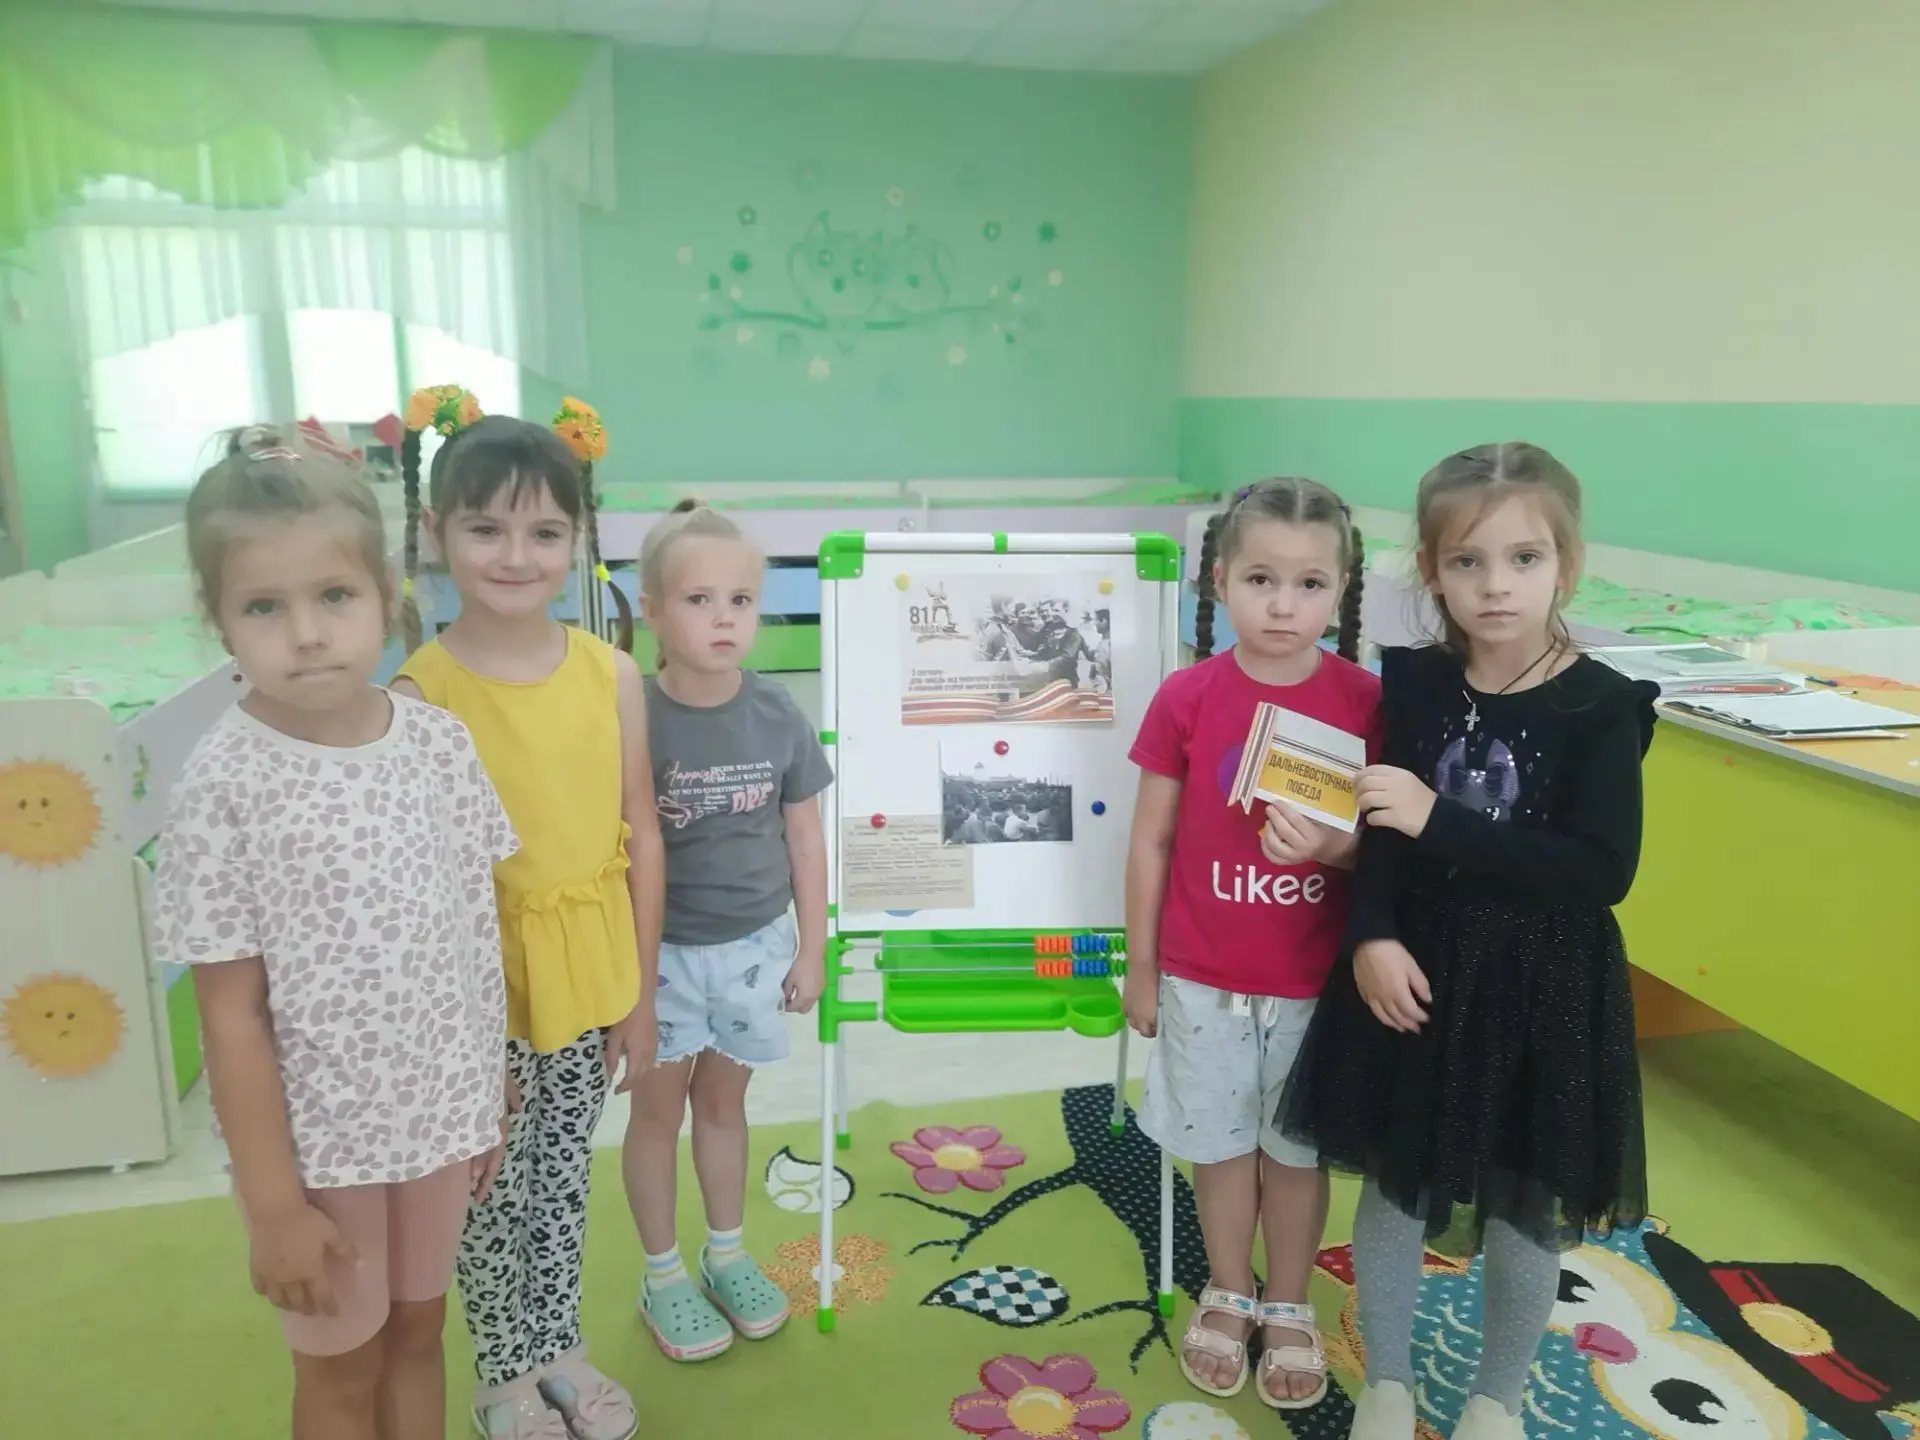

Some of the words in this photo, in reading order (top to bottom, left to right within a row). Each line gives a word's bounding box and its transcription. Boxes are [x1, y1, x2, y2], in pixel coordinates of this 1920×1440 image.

[910, 606, 928, 624] 81
[1268, 752, 1353, 794] ДАЛЬНЕВОСТОЧНАЯ
[1285, 778, 1322, 802] ПОБЕДА
[1212, 860, 1325, 906] Likee
